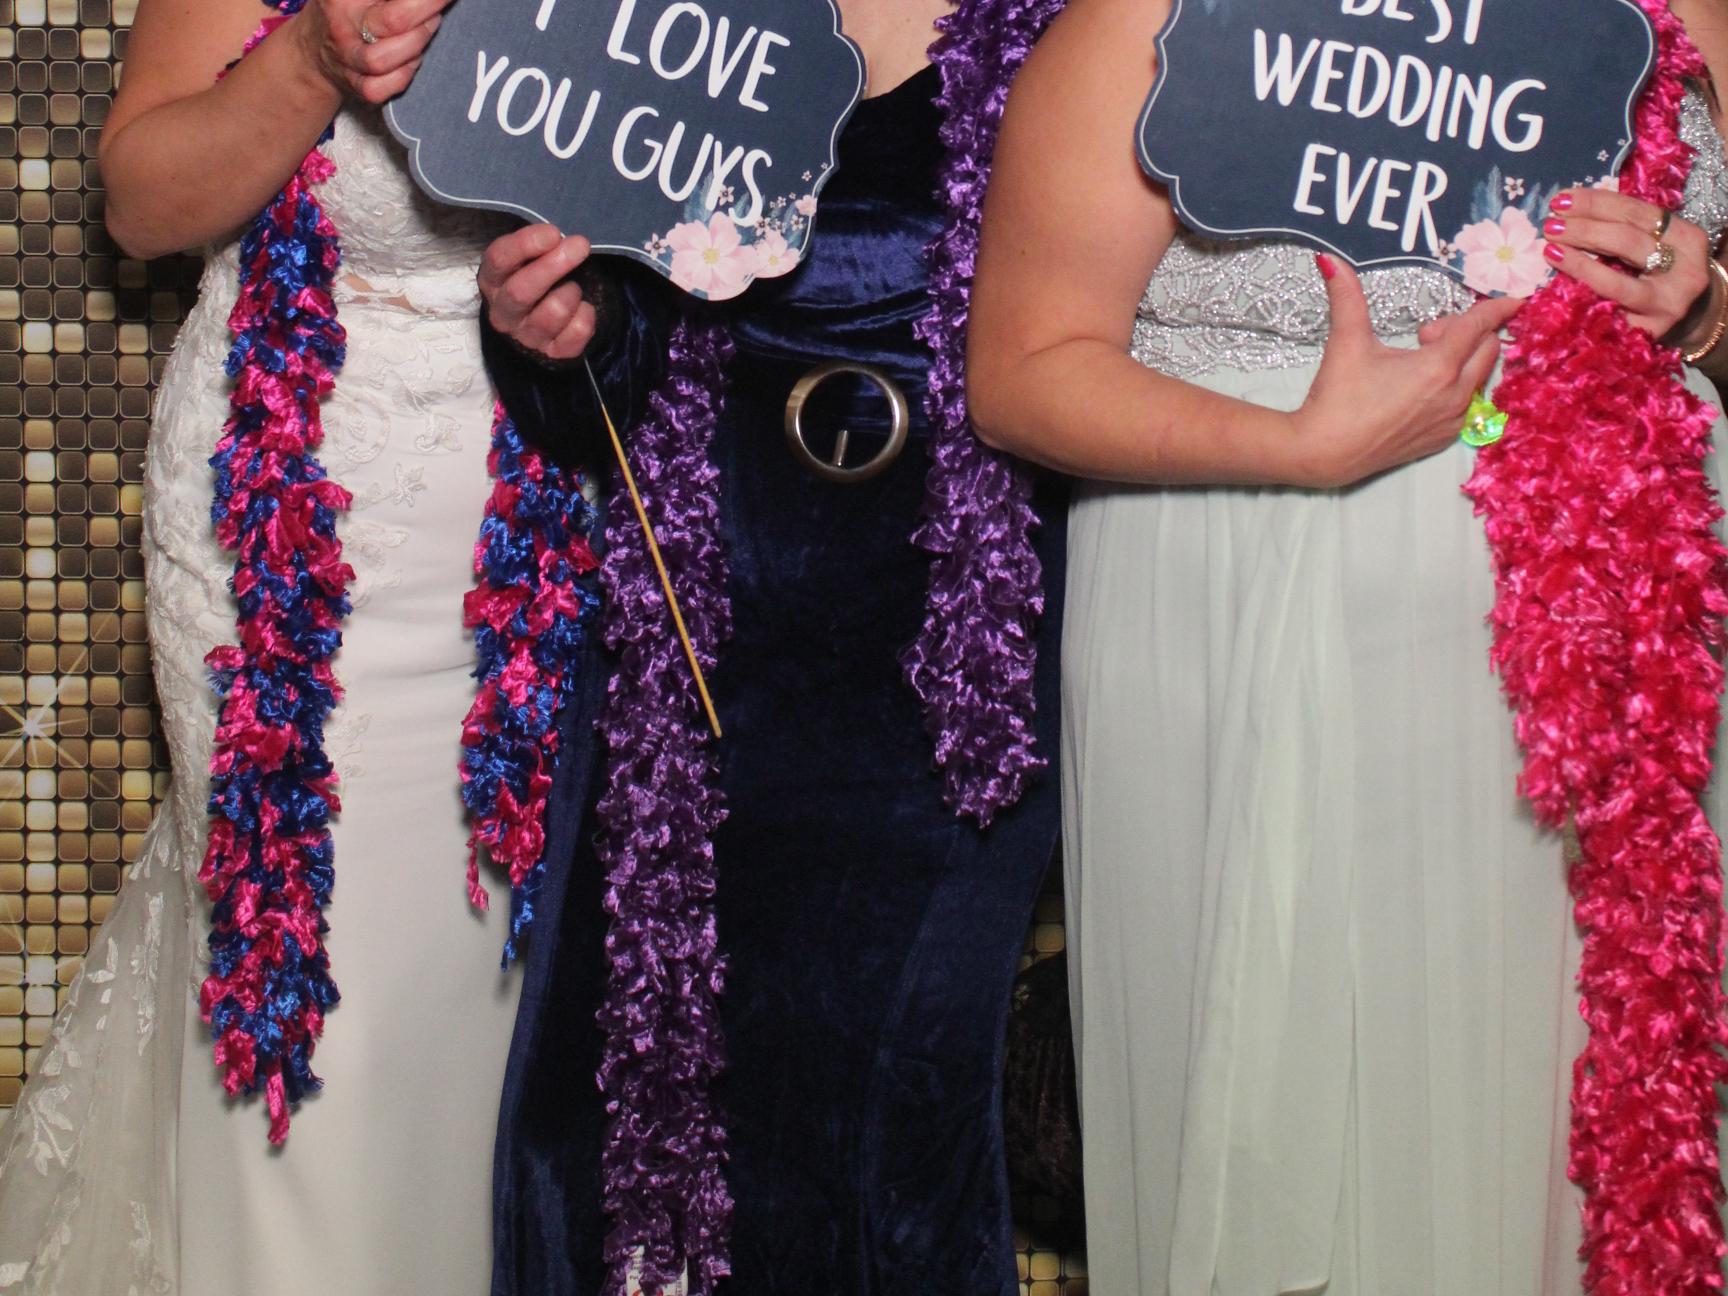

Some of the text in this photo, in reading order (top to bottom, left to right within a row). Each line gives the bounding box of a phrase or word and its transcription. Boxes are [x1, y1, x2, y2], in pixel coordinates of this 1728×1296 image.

[468, 50, 773, 227] YOU GUYS
[1253, 28, 1547, 152] WEDDING
[1293, 143, 1448, 253] EVER
